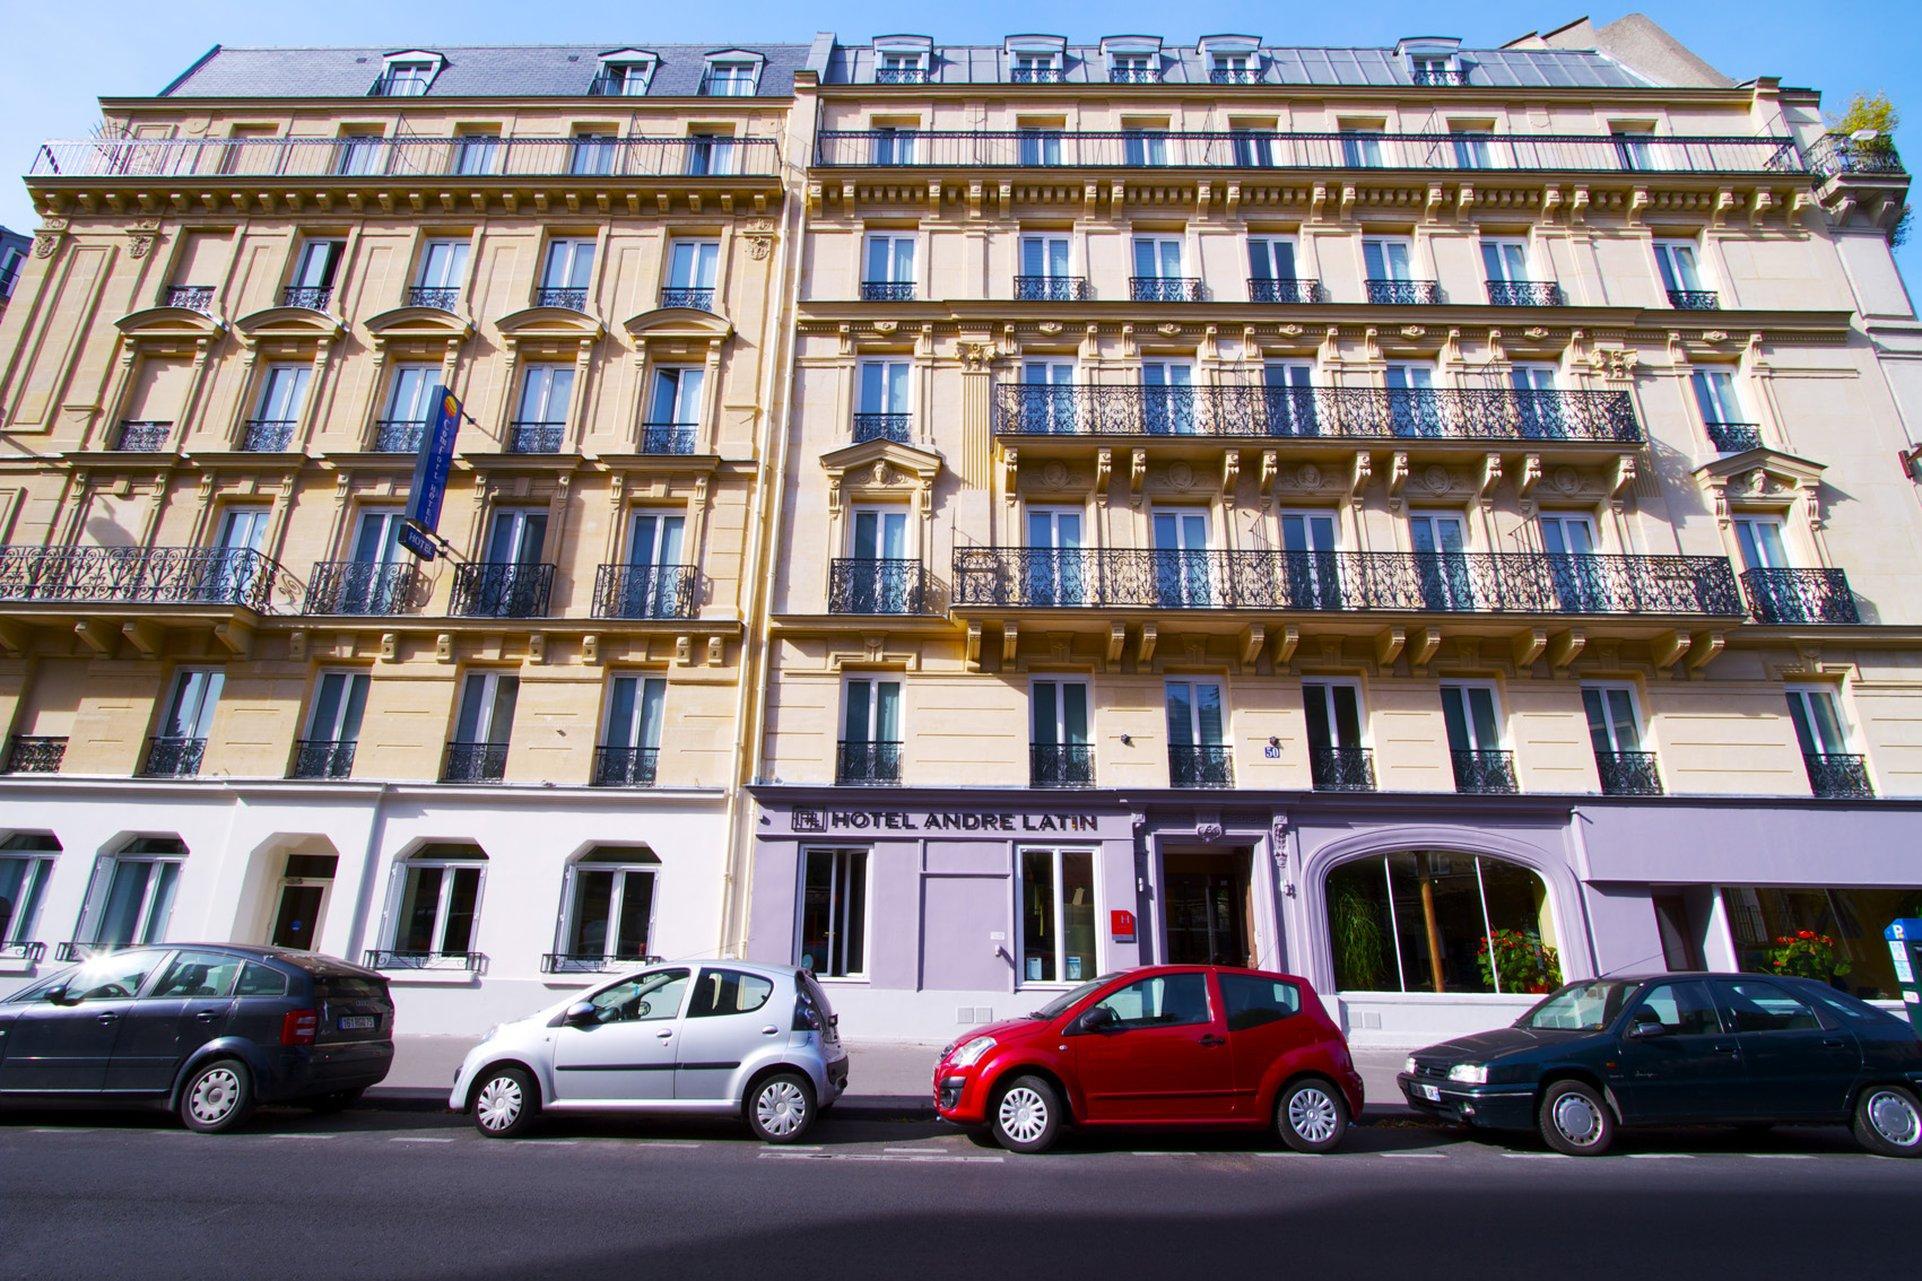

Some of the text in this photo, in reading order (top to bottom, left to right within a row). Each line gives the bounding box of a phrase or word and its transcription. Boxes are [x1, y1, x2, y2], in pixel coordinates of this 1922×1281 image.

[408, 531, 433, 556] HOTEL
[1266, 747, 1279, 758] 50
[832, 811, 1098, 832] HOTEL ANDRE LATIN
[1892, 924, 1904, 940] P
